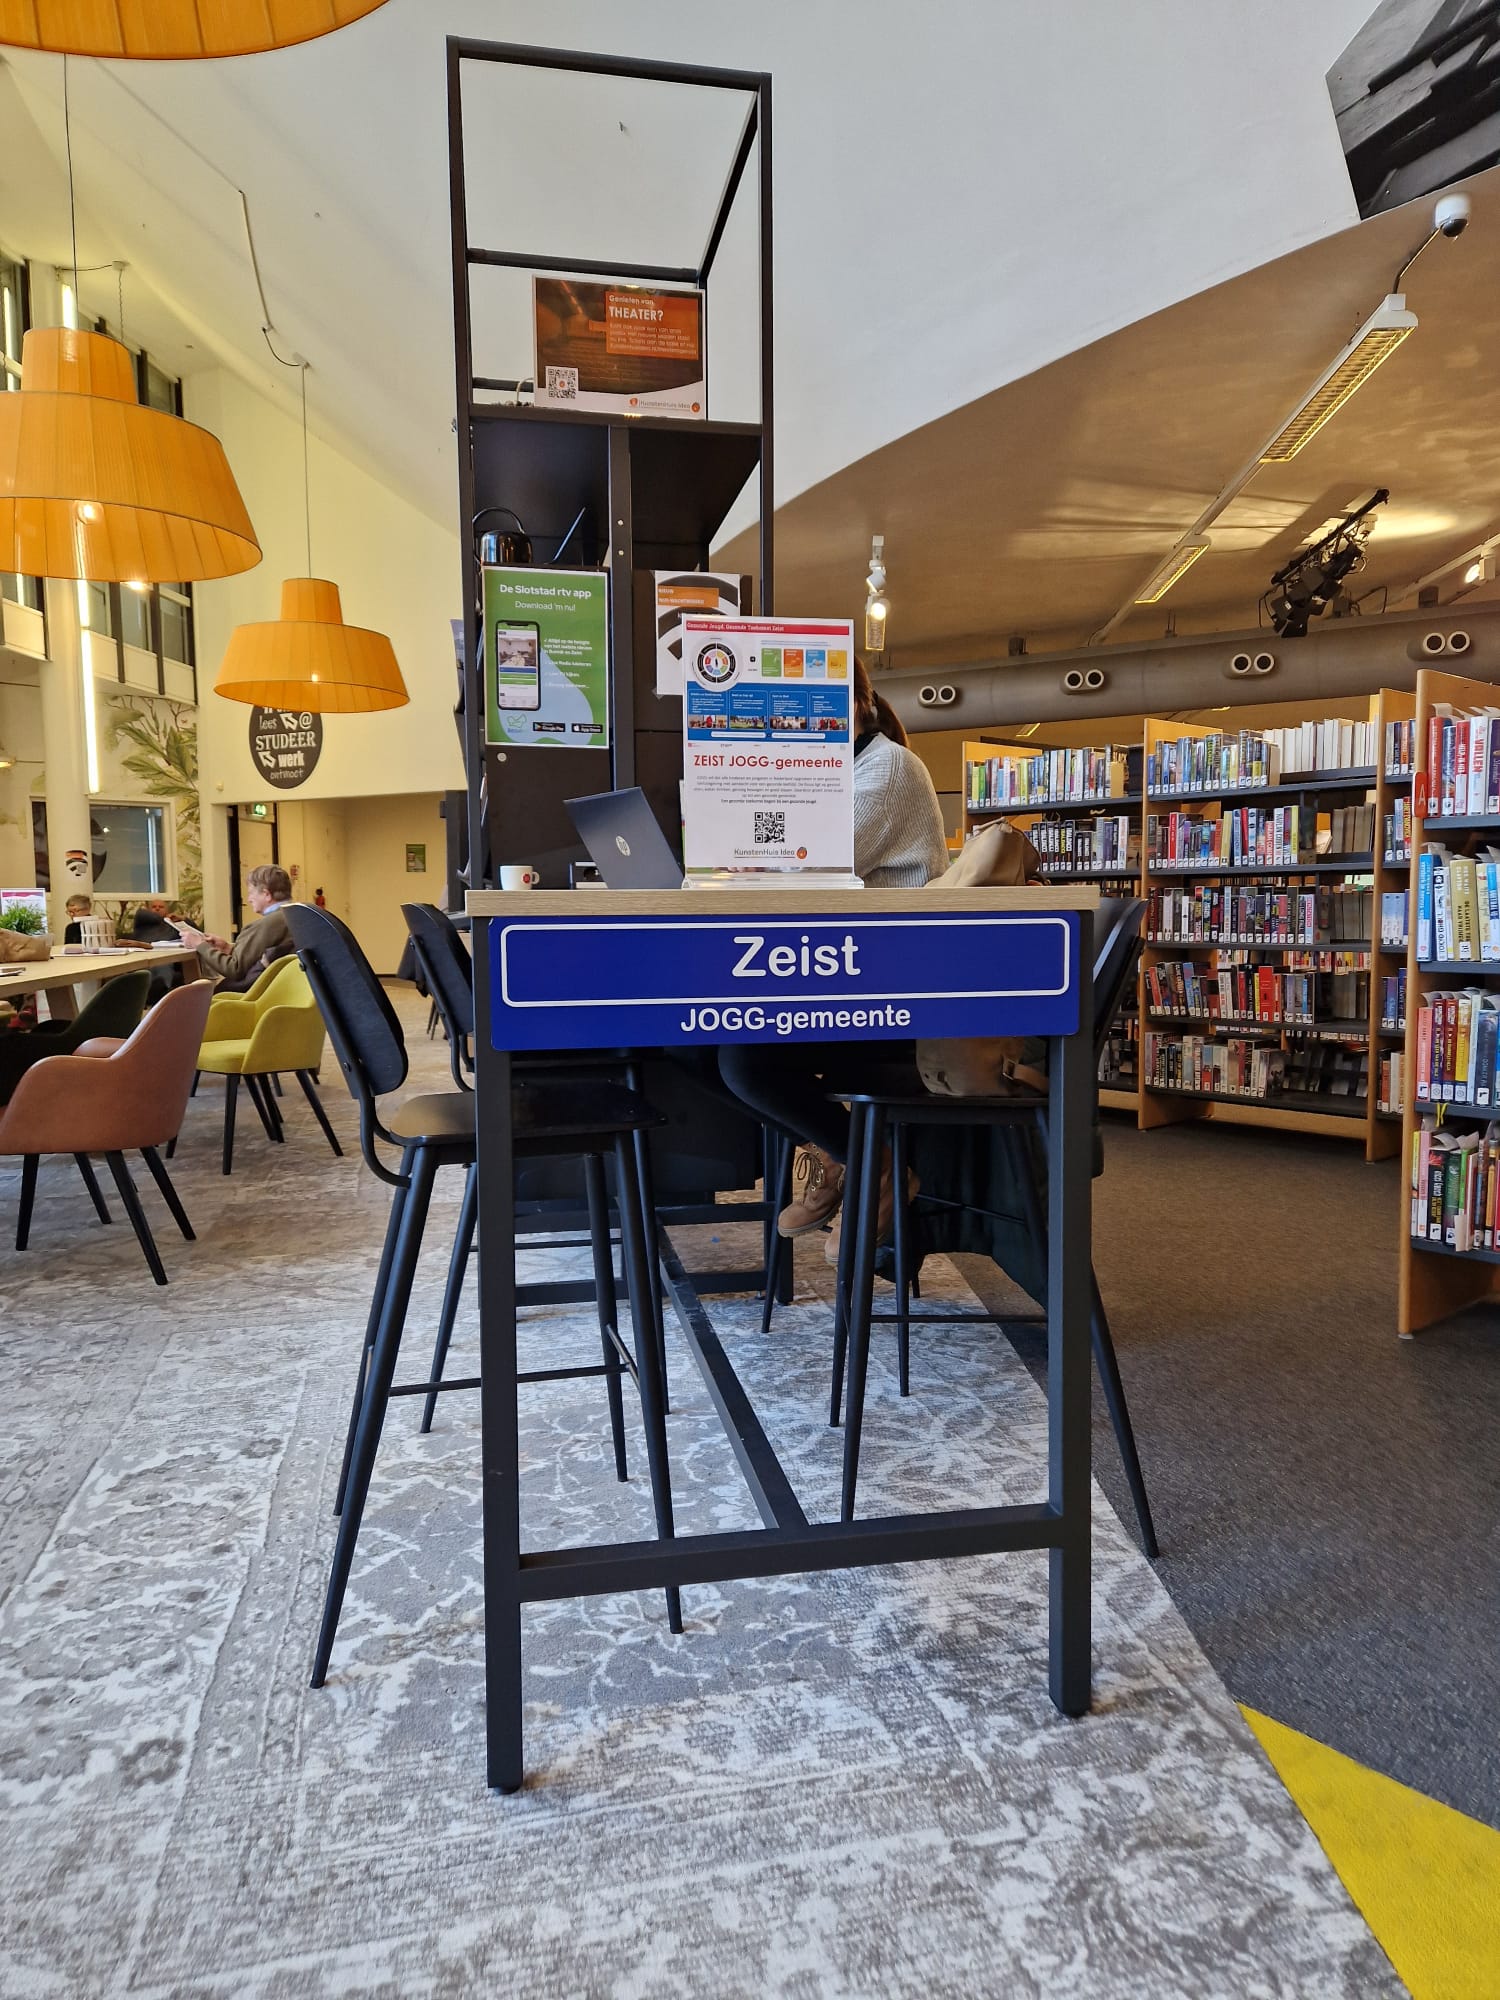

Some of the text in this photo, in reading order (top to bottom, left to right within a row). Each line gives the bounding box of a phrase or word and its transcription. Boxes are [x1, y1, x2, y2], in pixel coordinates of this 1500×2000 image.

[609, 294, 640, 305] Genieten
[609, 306, 664, 322] THEATER?
[499, 584, 592, 599] De Slotstad rtv app
[515, 601, 553, 611] Download
[256, 731, 316, 750] STUDEER
[278, 751, 304, 767] werk
[693, 754, 843, 770] ZEIST JOGG-gemeente
[1418, 784, 1426, 807] A
[734, 848, 795, 857] KunstenHuis Idea
[731, 935, 862, 978] Zeist
[680, 1004, 911, 1036] JOGG-gemeente
